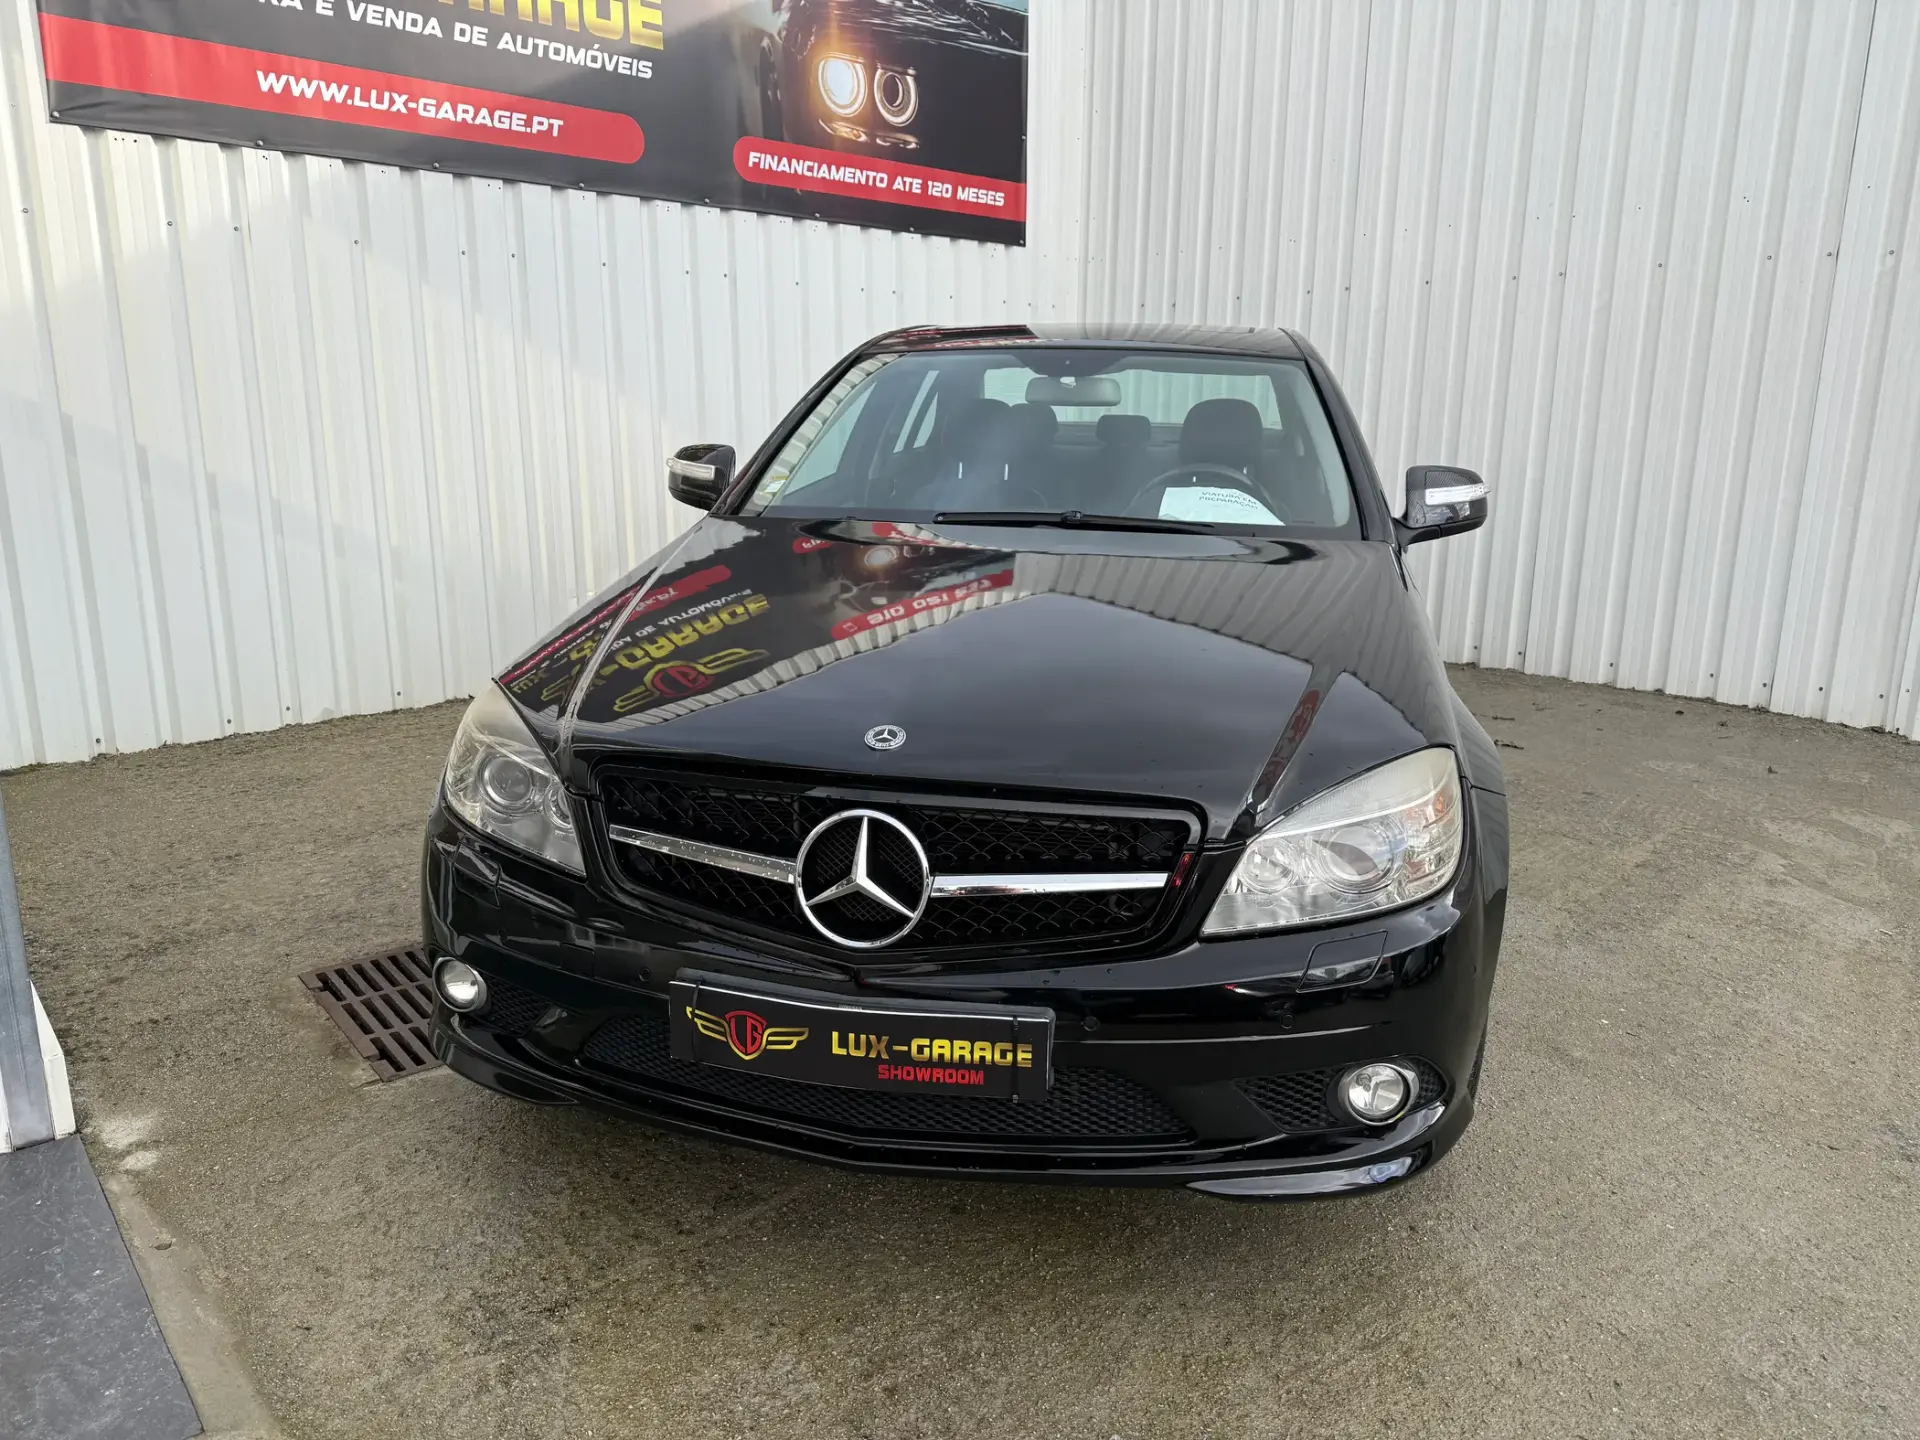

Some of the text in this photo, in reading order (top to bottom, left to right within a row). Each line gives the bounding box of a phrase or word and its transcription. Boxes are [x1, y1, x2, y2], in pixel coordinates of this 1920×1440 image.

[347, 0, 443, 38] VENDA
[454, 21, 488, 47] DE
[497, 32, 653, 79] AUTOMÓVEIS
[256, 70, 564, 137] WWW.LUX-GARAGE.PT
[748, 152, 1005, 207] FINANCIAMENTO ATE 120 MESES
[831, 1031, 1033, 1068] LUX-GARAGE
[878, 1064, 985, 1085] SHOWROOM
